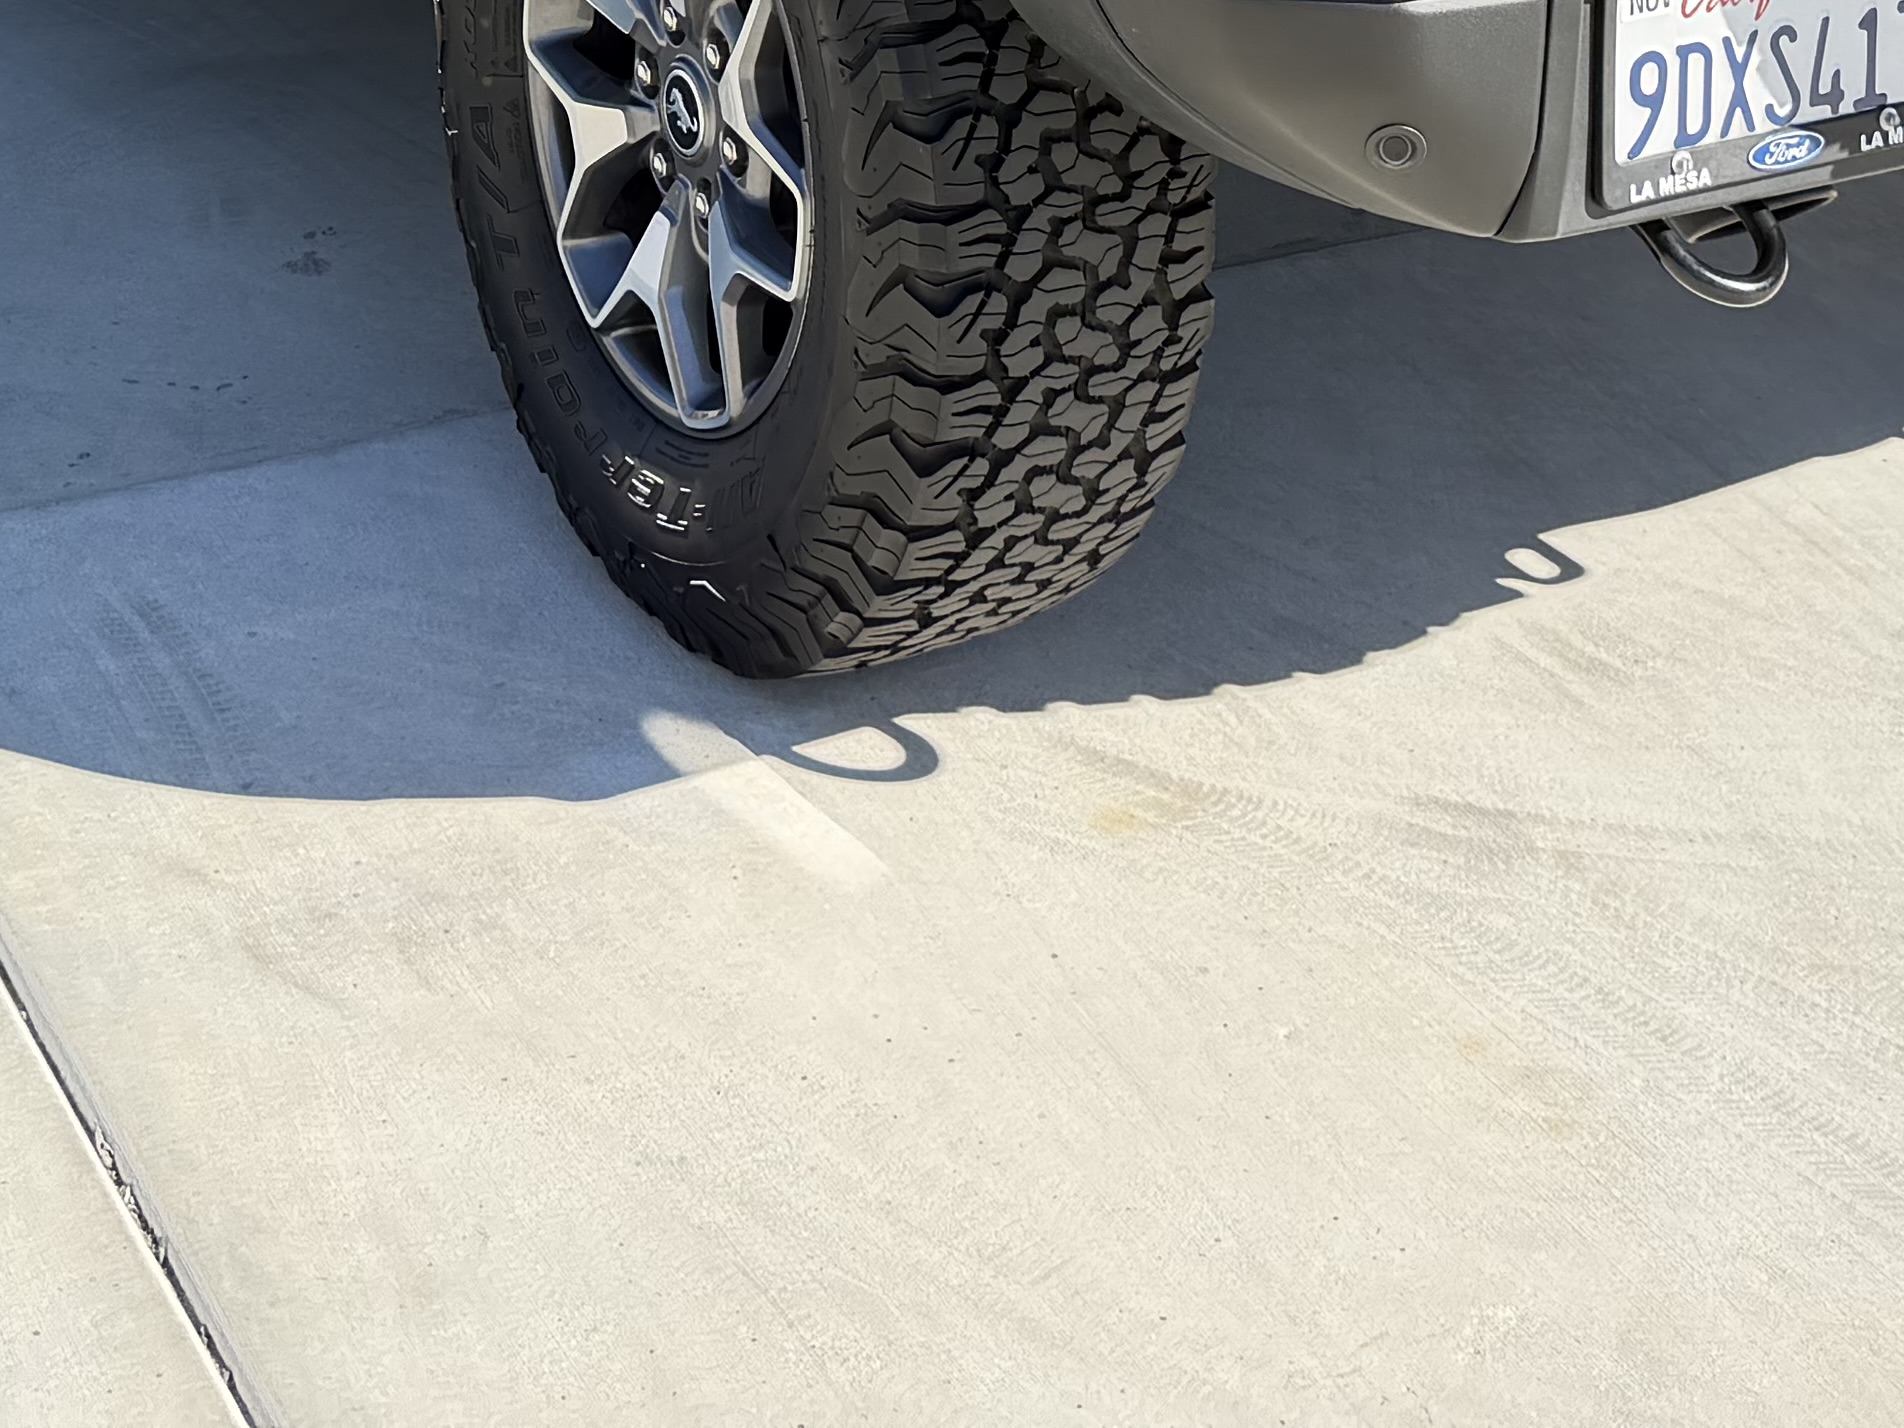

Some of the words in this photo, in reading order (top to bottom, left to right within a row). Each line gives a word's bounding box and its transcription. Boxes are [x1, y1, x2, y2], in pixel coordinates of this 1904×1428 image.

[1764, 136, 1810, 166] Ford
[1860, 131, 1884, 153] LA
[1629, 181, 1655, 204] LA
[1658, 166, 1713, 196] MESA
